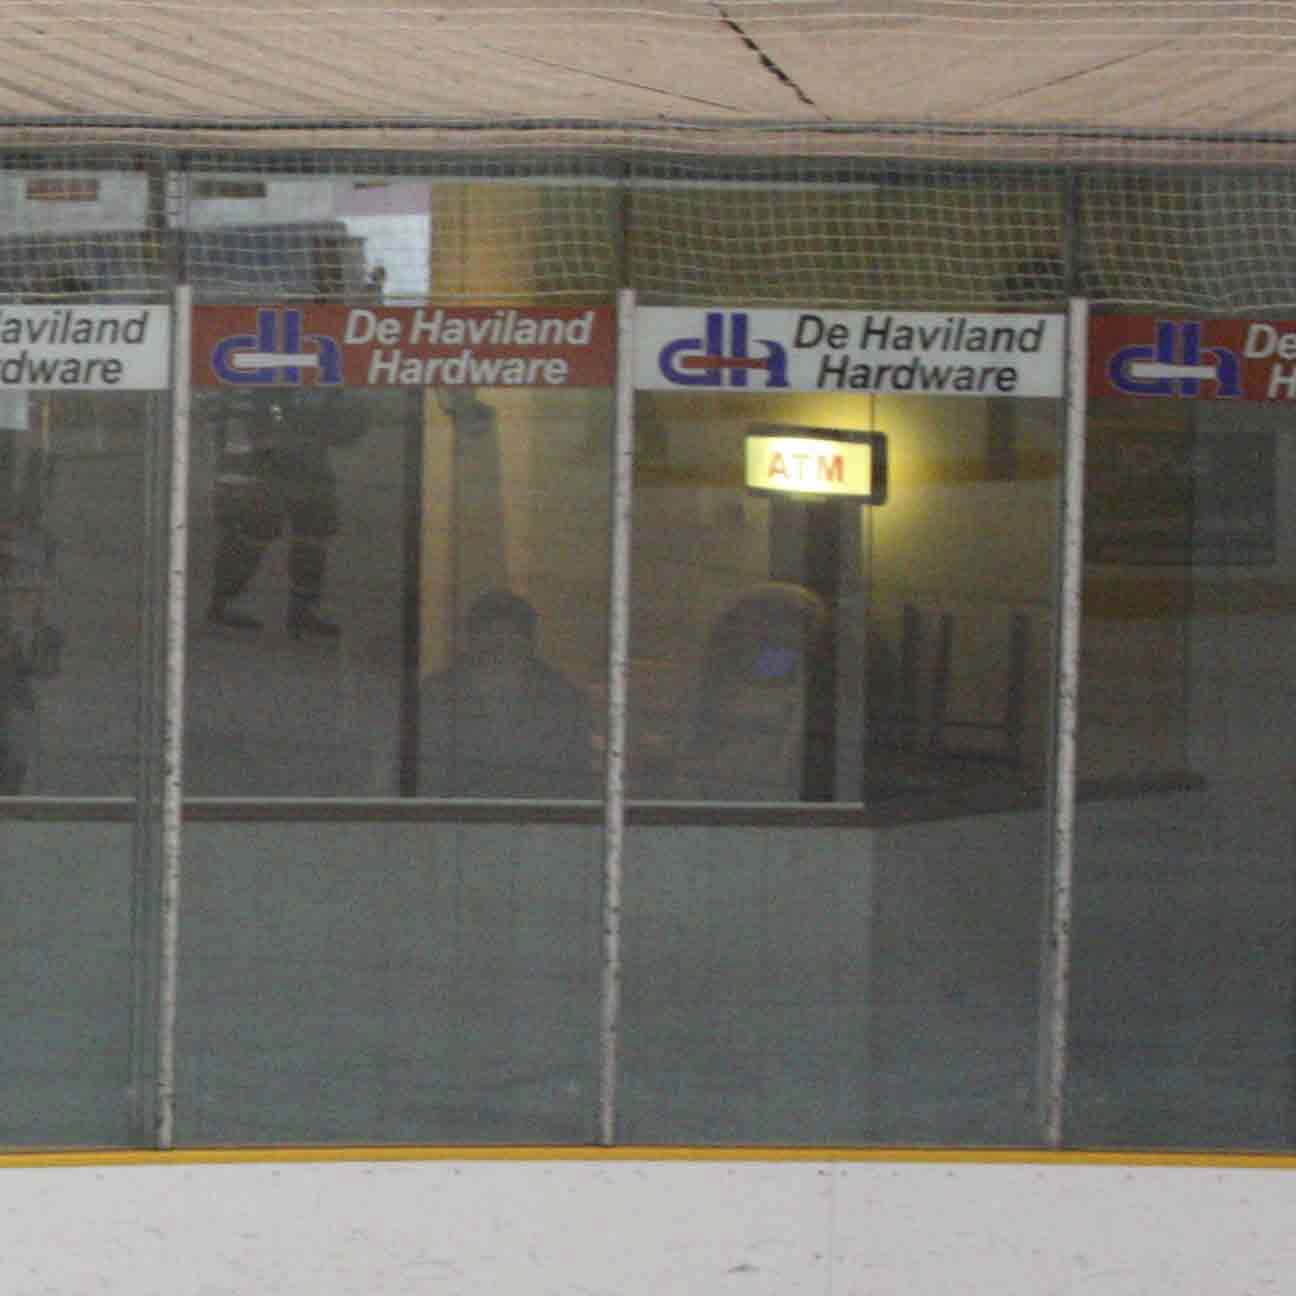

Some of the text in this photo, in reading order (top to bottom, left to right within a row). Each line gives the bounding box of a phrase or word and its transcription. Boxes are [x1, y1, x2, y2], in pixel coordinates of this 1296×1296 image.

[343, 307, 595, 346] De Haviland
[793, 314, 1046, 353] De Haviland
[367, 349, 569, 386] Hardware
[816, 355, 1018, 392] Hardware
[768, 452, 844, 482] ATM
